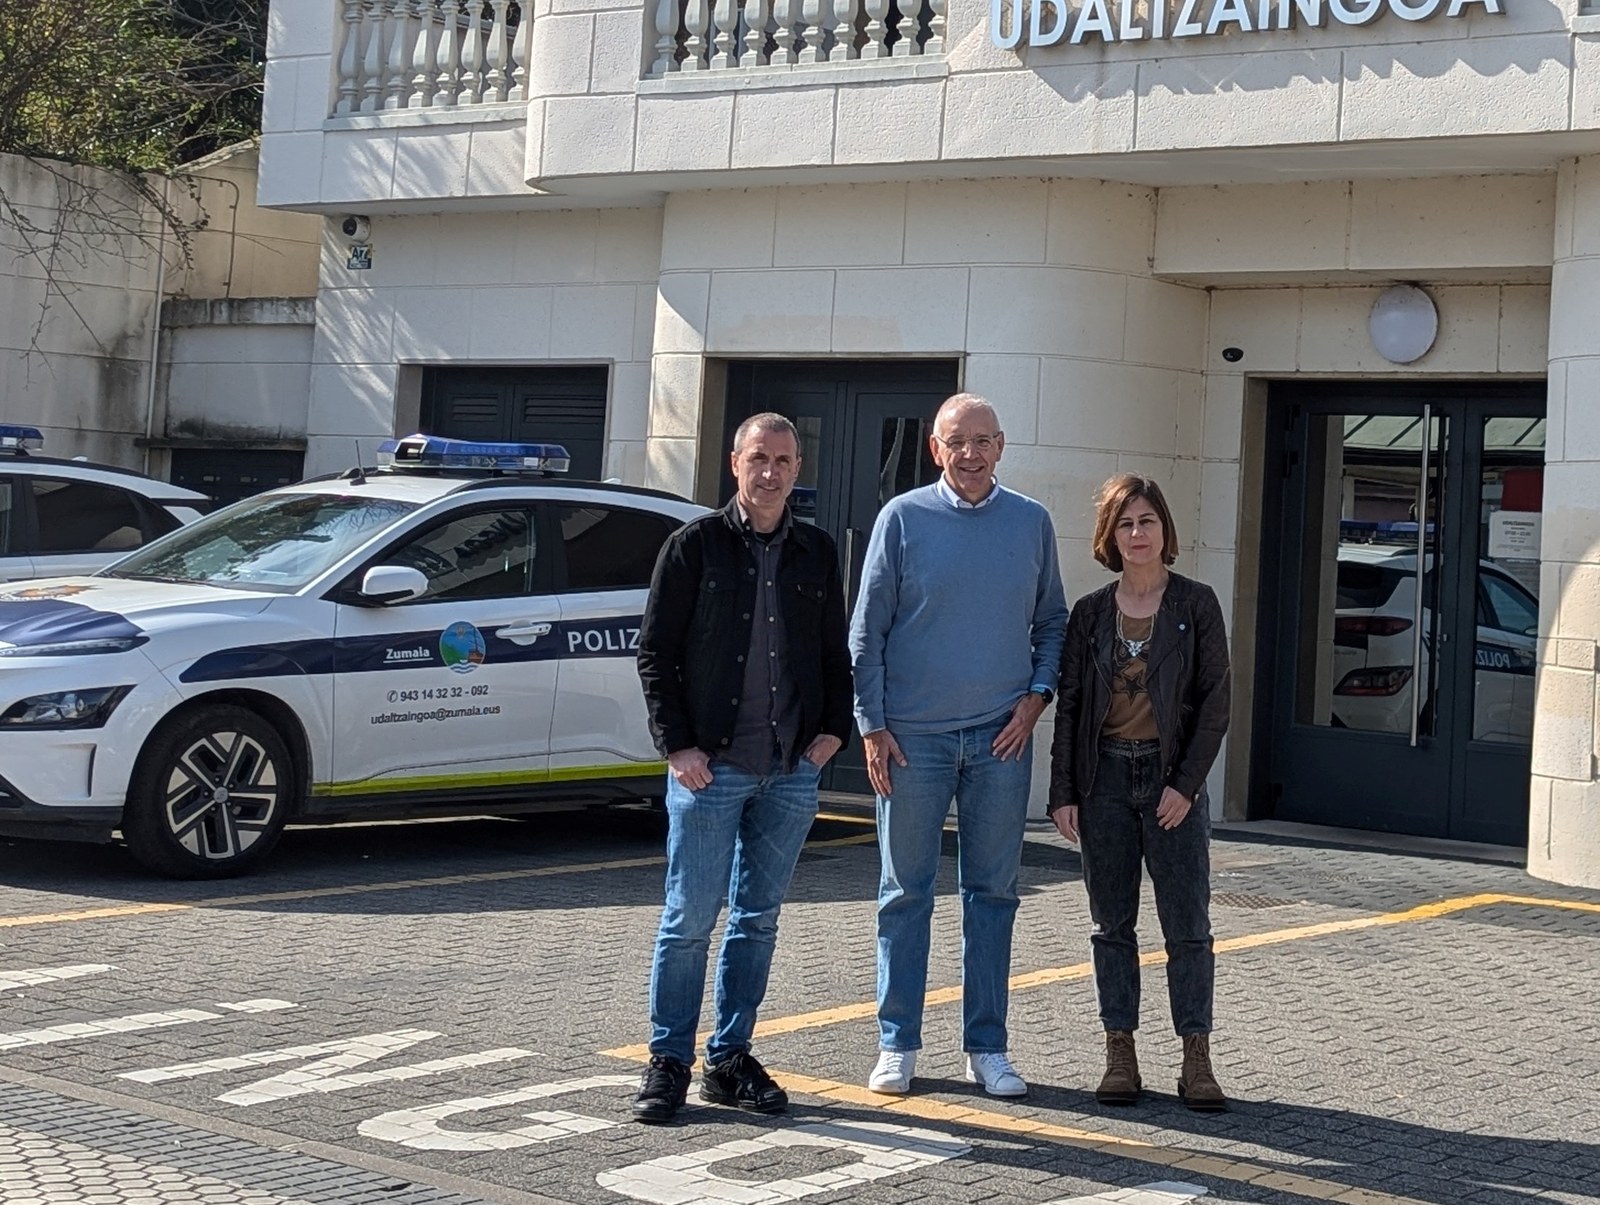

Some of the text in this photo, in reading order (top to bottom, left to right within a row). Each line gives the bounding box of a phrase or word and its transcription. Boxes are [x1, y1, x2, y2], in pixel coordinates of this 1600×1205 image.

[400, 690, 419, 702] 943
[421, 689, 433, 700] 14
[435, 688, 448, 699] 32
[450, 686, 463, 698] 32
[471, 685, 489, 696] 092
[371, 705, 501, 724] udaltzaingoa@zumaia.eus
